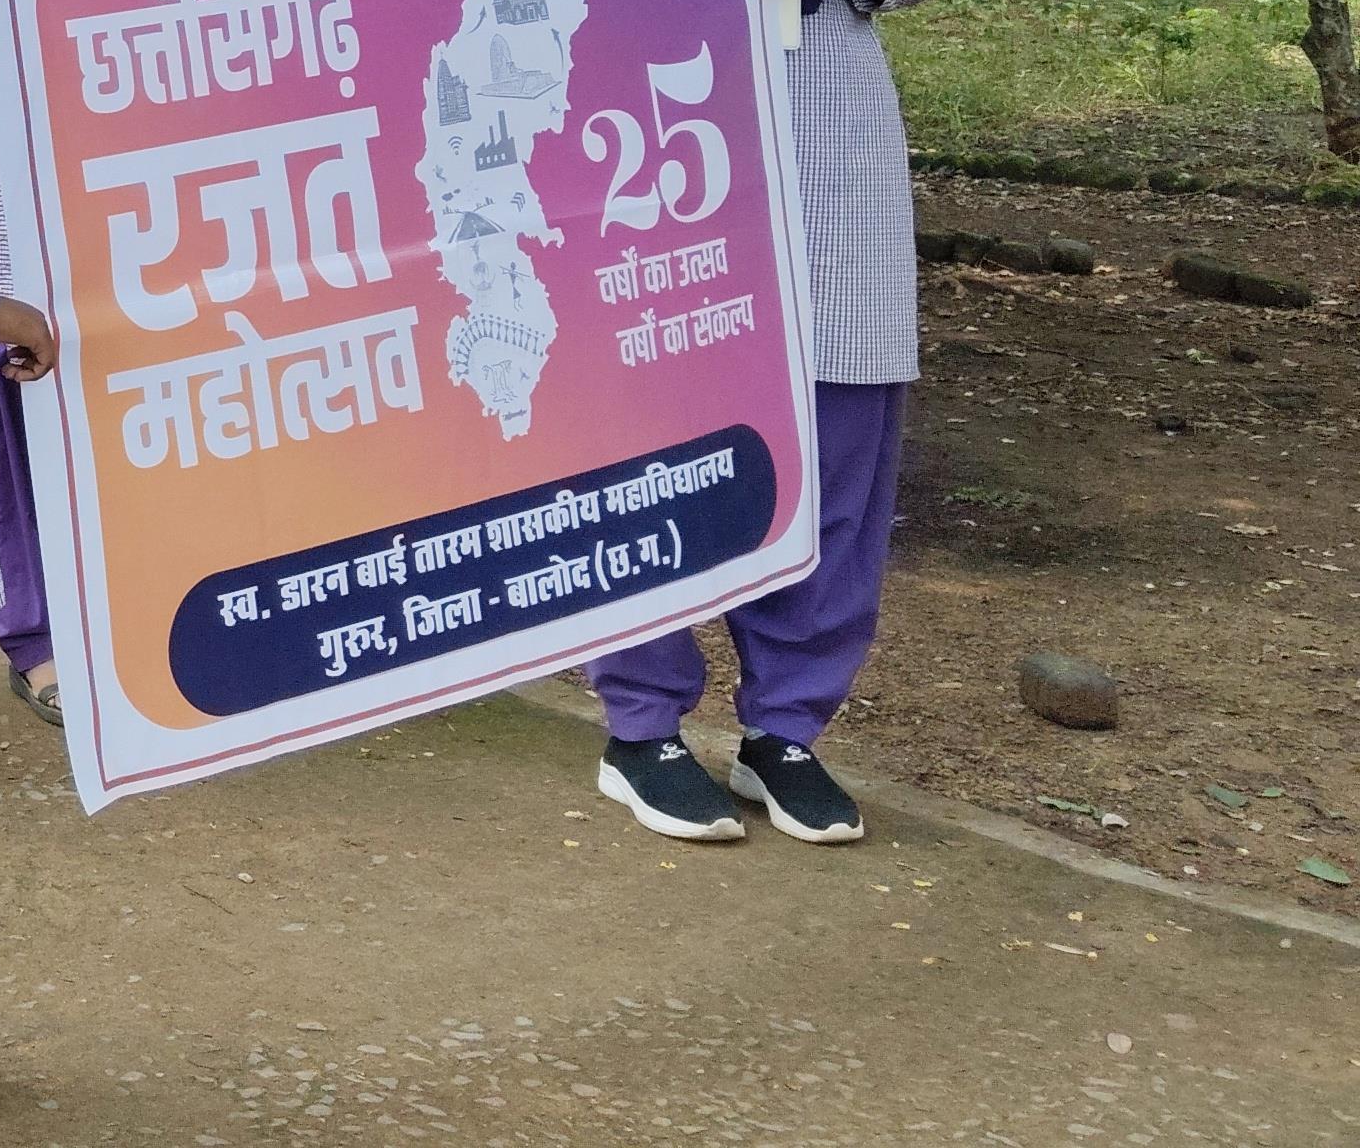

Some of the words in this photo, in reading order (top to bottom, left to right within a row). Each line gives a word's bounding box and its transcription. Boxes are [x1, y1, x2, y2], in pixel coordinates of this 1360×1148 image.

[82, 106, 393, 332] रजत
[580, 40, 732, 238] 25
[593, 245, 640, 305] वर्षों
[640, 252, 673, 294] का
[672, 237, 729, 287] उत्सव
[615, 308, 658, 367] वर्षों
[659, 313, 690, 355] का
[690, 294, 755, 347] संकल्प
[107, 305, 424, 469] महोत्सव
[216, 585, 271, 627] स्व.
[277, 561, 350, 612] डारन
[353, 533, 408, 588] बाई
[411, 524, 482, 574] तारम
[485, 490, 601, 552] शासकीय
[605, 447, 735, 517] महाविद्यालय
[402, 587, 483, 642] जिला
